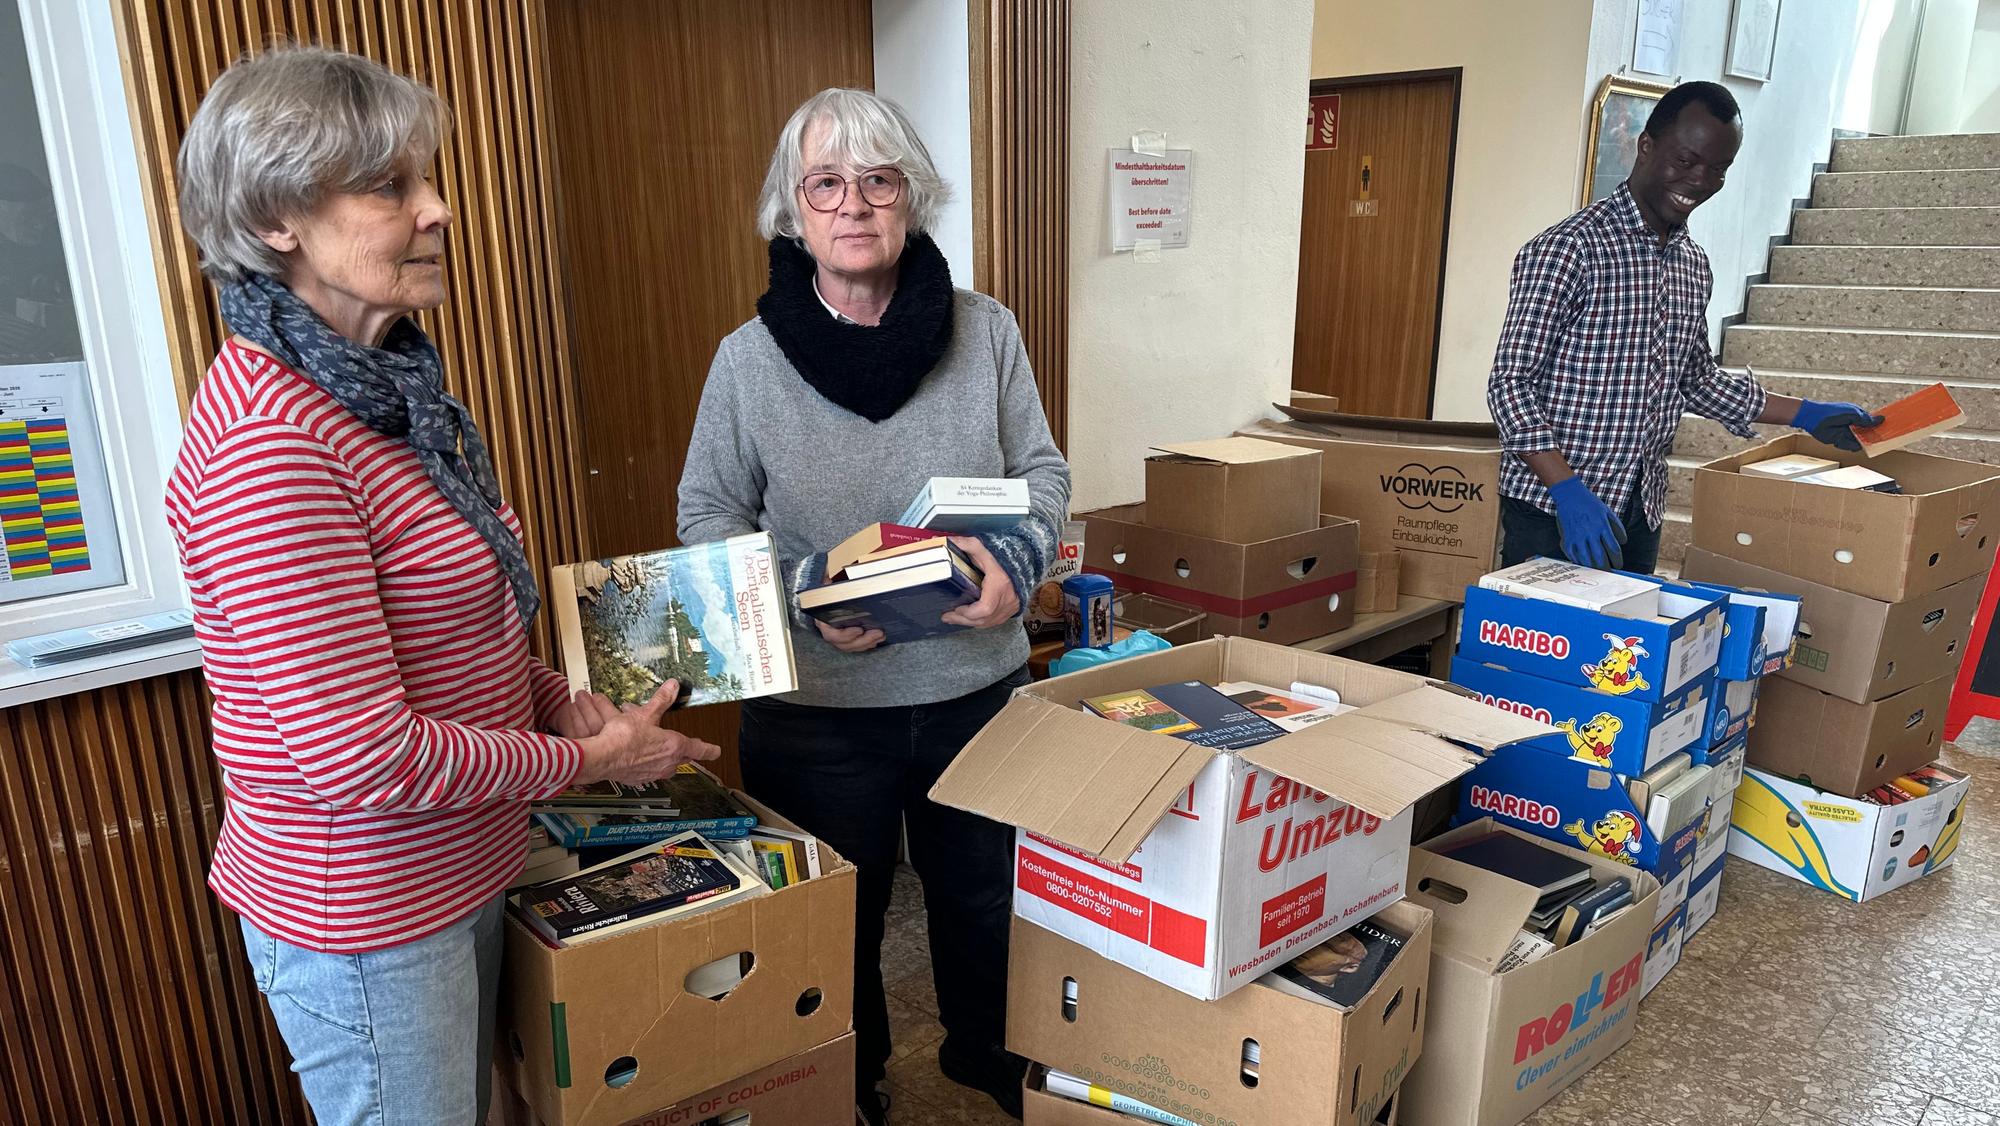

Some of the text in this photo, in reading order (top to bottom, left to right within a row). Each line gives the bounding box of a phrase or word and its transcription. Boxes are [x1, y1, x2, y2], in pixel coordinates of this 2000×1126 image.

[1115, 162, 1185, 171] Mindesthaltbarkeitsdatum
[1131, 177, 1169, 186] überschritten!
[1128, 206, 1171, 216] Best before date
[1356, 201, 1371, 214] WC
[1136, 220, 1162, 229] exceeded!
[1380, 474, 1485, 502] VORWERK
[1397, 515, 1459, 535] Raumpflege
[757, 556, 770, 585] Die
[736, 591, 751, 632] Seen
[1481, 621, 1569, 659] HARIBO
[1472, 786, 1559, 827] HARIBO
[1832, 808, 1855, 816] CLASS
[565, 885, 599, 914] Riviera
[1021, 857, 1144, 918] Kostenfreie Info-Nummer
[1046, 881, 1112, 918] 0800-0207552
[1263, 887, 1325, 924] Familien-Betrieb
[1276, 906, 1311, 930] seit 1970
[572, 913, 628, 934] Italienische Riviera
[1228, 883, 1400, 979] Wiesbaden Dietzenbach Aschaffenburg
[1514, 951, 1643, 1065] ROLLER
[1516, 1053, 1562, 1091] Clever
[1563, 998, 1632, 1061] einrichten!
[698, 1096, 722, 1114] OF
[727, 1064, 818, 1105] COLOMBIA
[1113, 1099, 1159, 1119] GEOMETRIC
